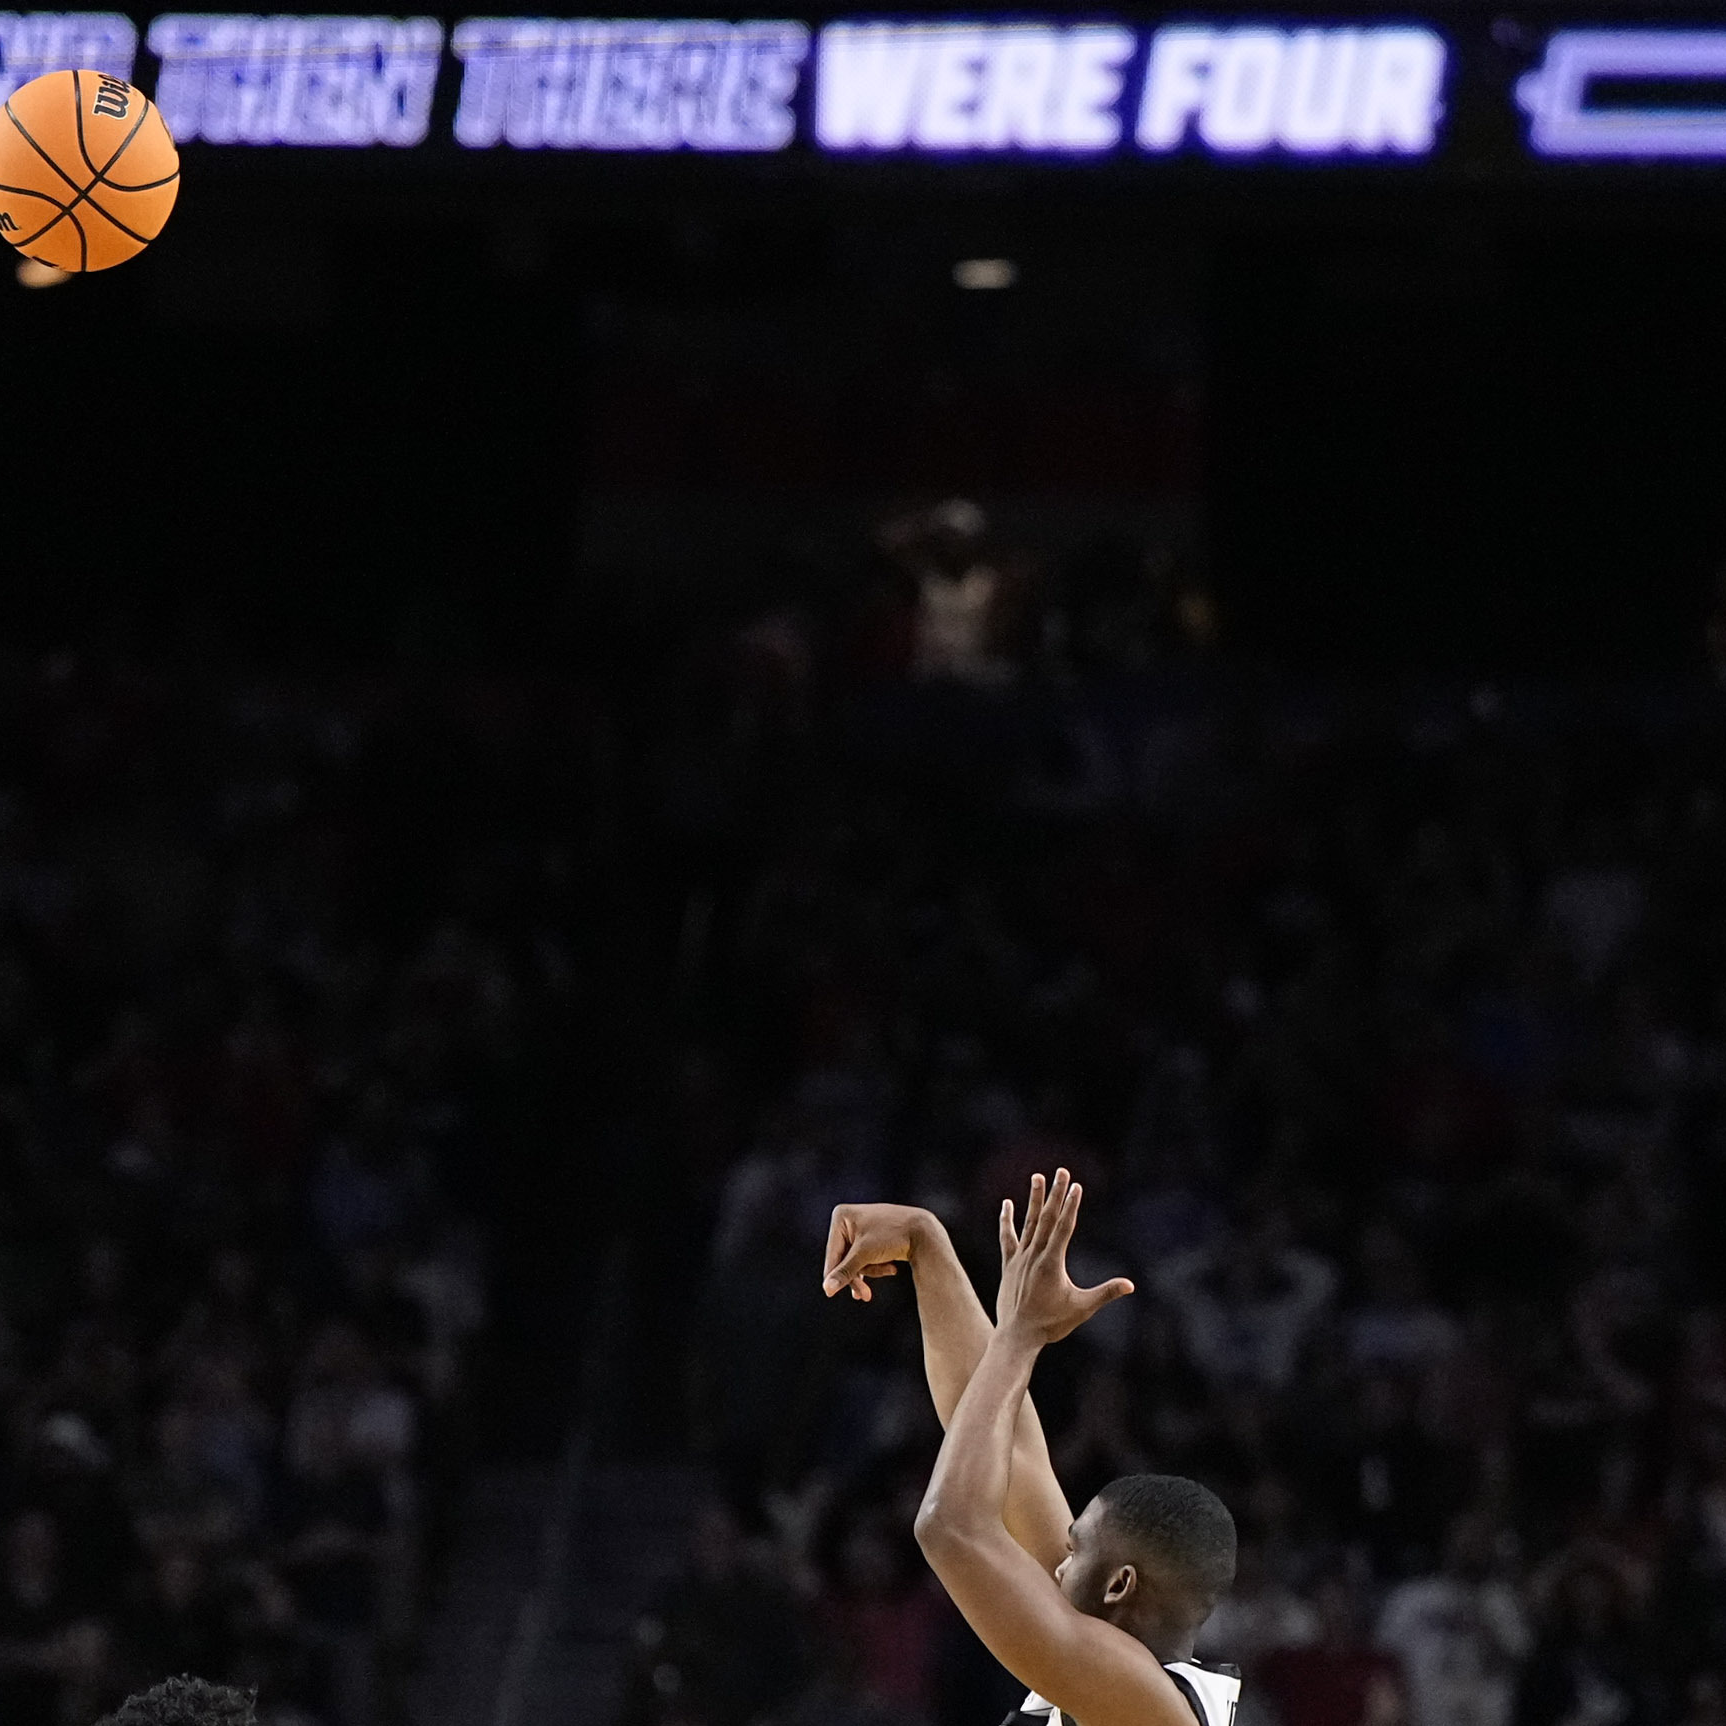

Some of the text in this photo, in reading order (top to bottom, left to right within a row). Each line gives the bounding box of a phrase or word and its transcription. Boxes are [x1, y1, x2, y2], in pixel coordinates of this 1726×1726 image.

[147, 16, 443, 147] THEN
[451, 18, 810, 152] THERE
[816, 21, 1136, 151] WERE
[1136, 25, 1447, 153] FOUR
